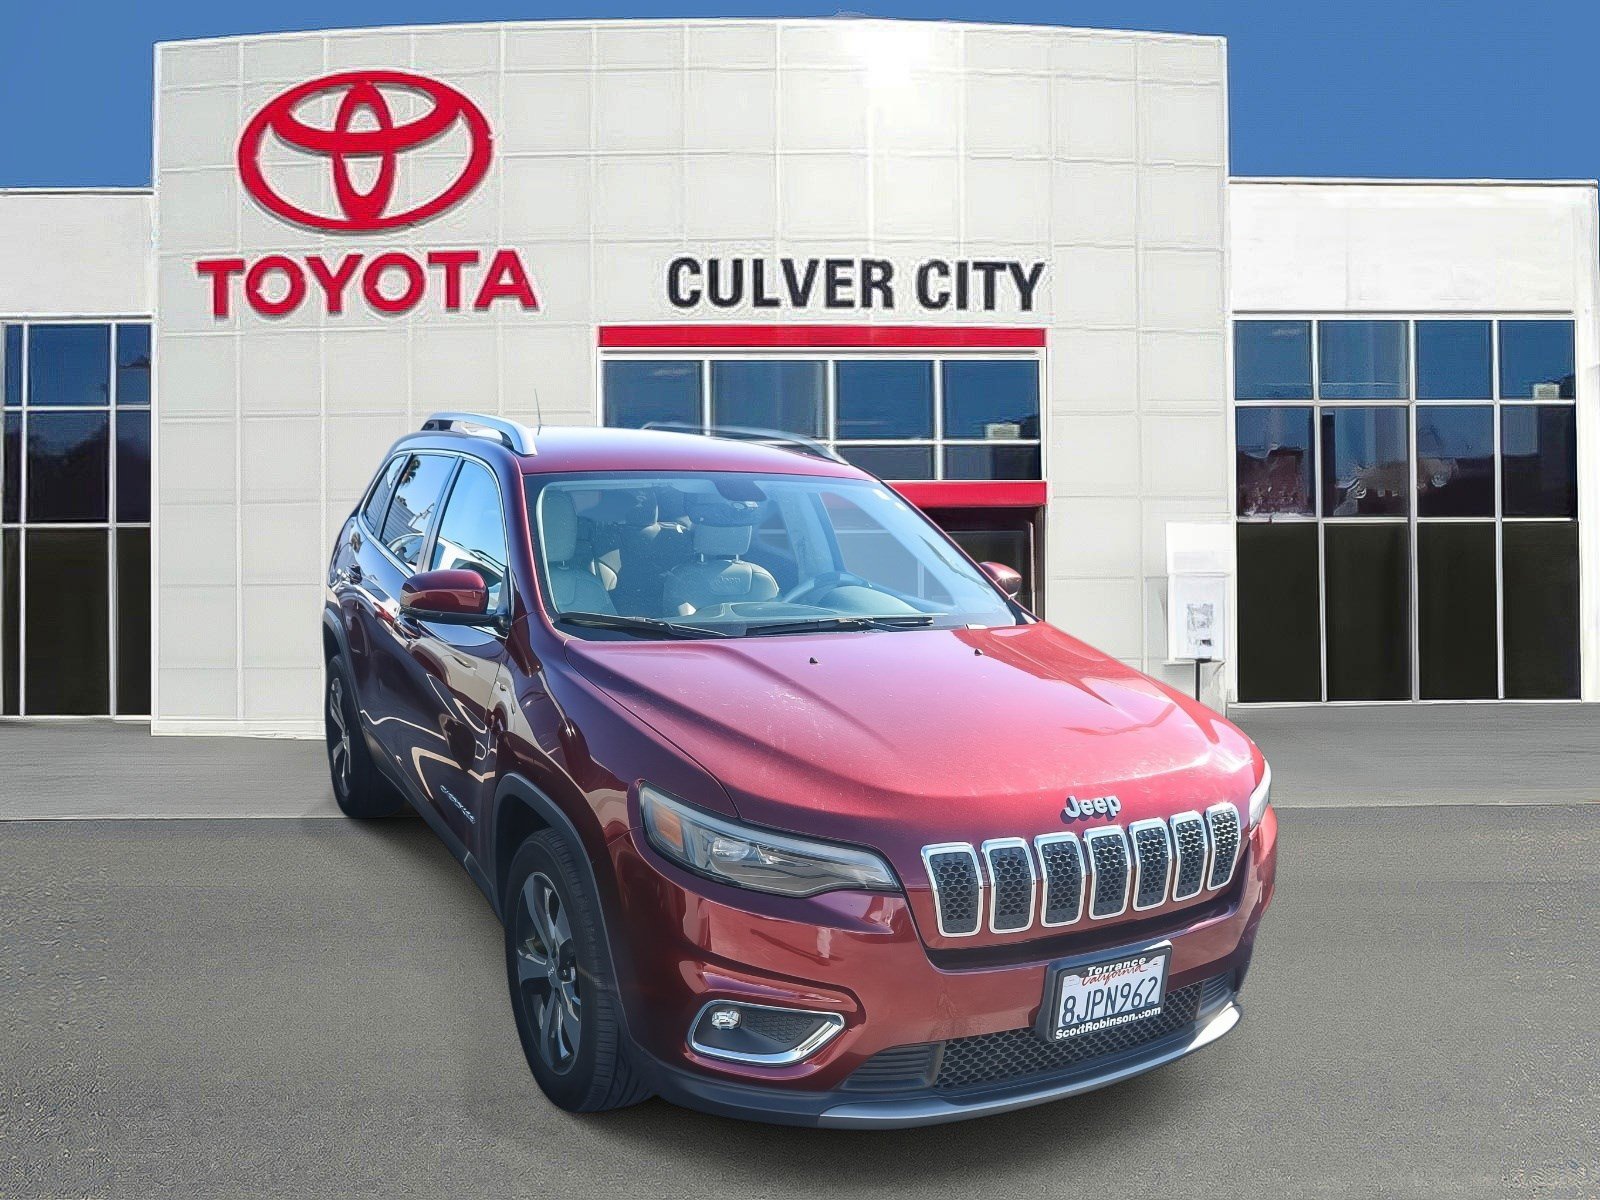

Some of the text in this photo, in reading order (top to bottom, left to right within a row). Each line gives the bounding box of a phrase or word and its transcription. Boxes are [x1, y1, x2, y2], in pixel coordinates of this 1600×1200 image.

[197, 250, 538, 318] TOYOTA
[667, 257, 1045, 310] CULVER CITY
[1063, 795, 1122, 820] Jeep
[1087, 957, 1147, 977] Torrance
[1061, 976, 1158, 1027] 8JPN962
[1055, 1006, 1161, 1040] ScottRobinson.com
